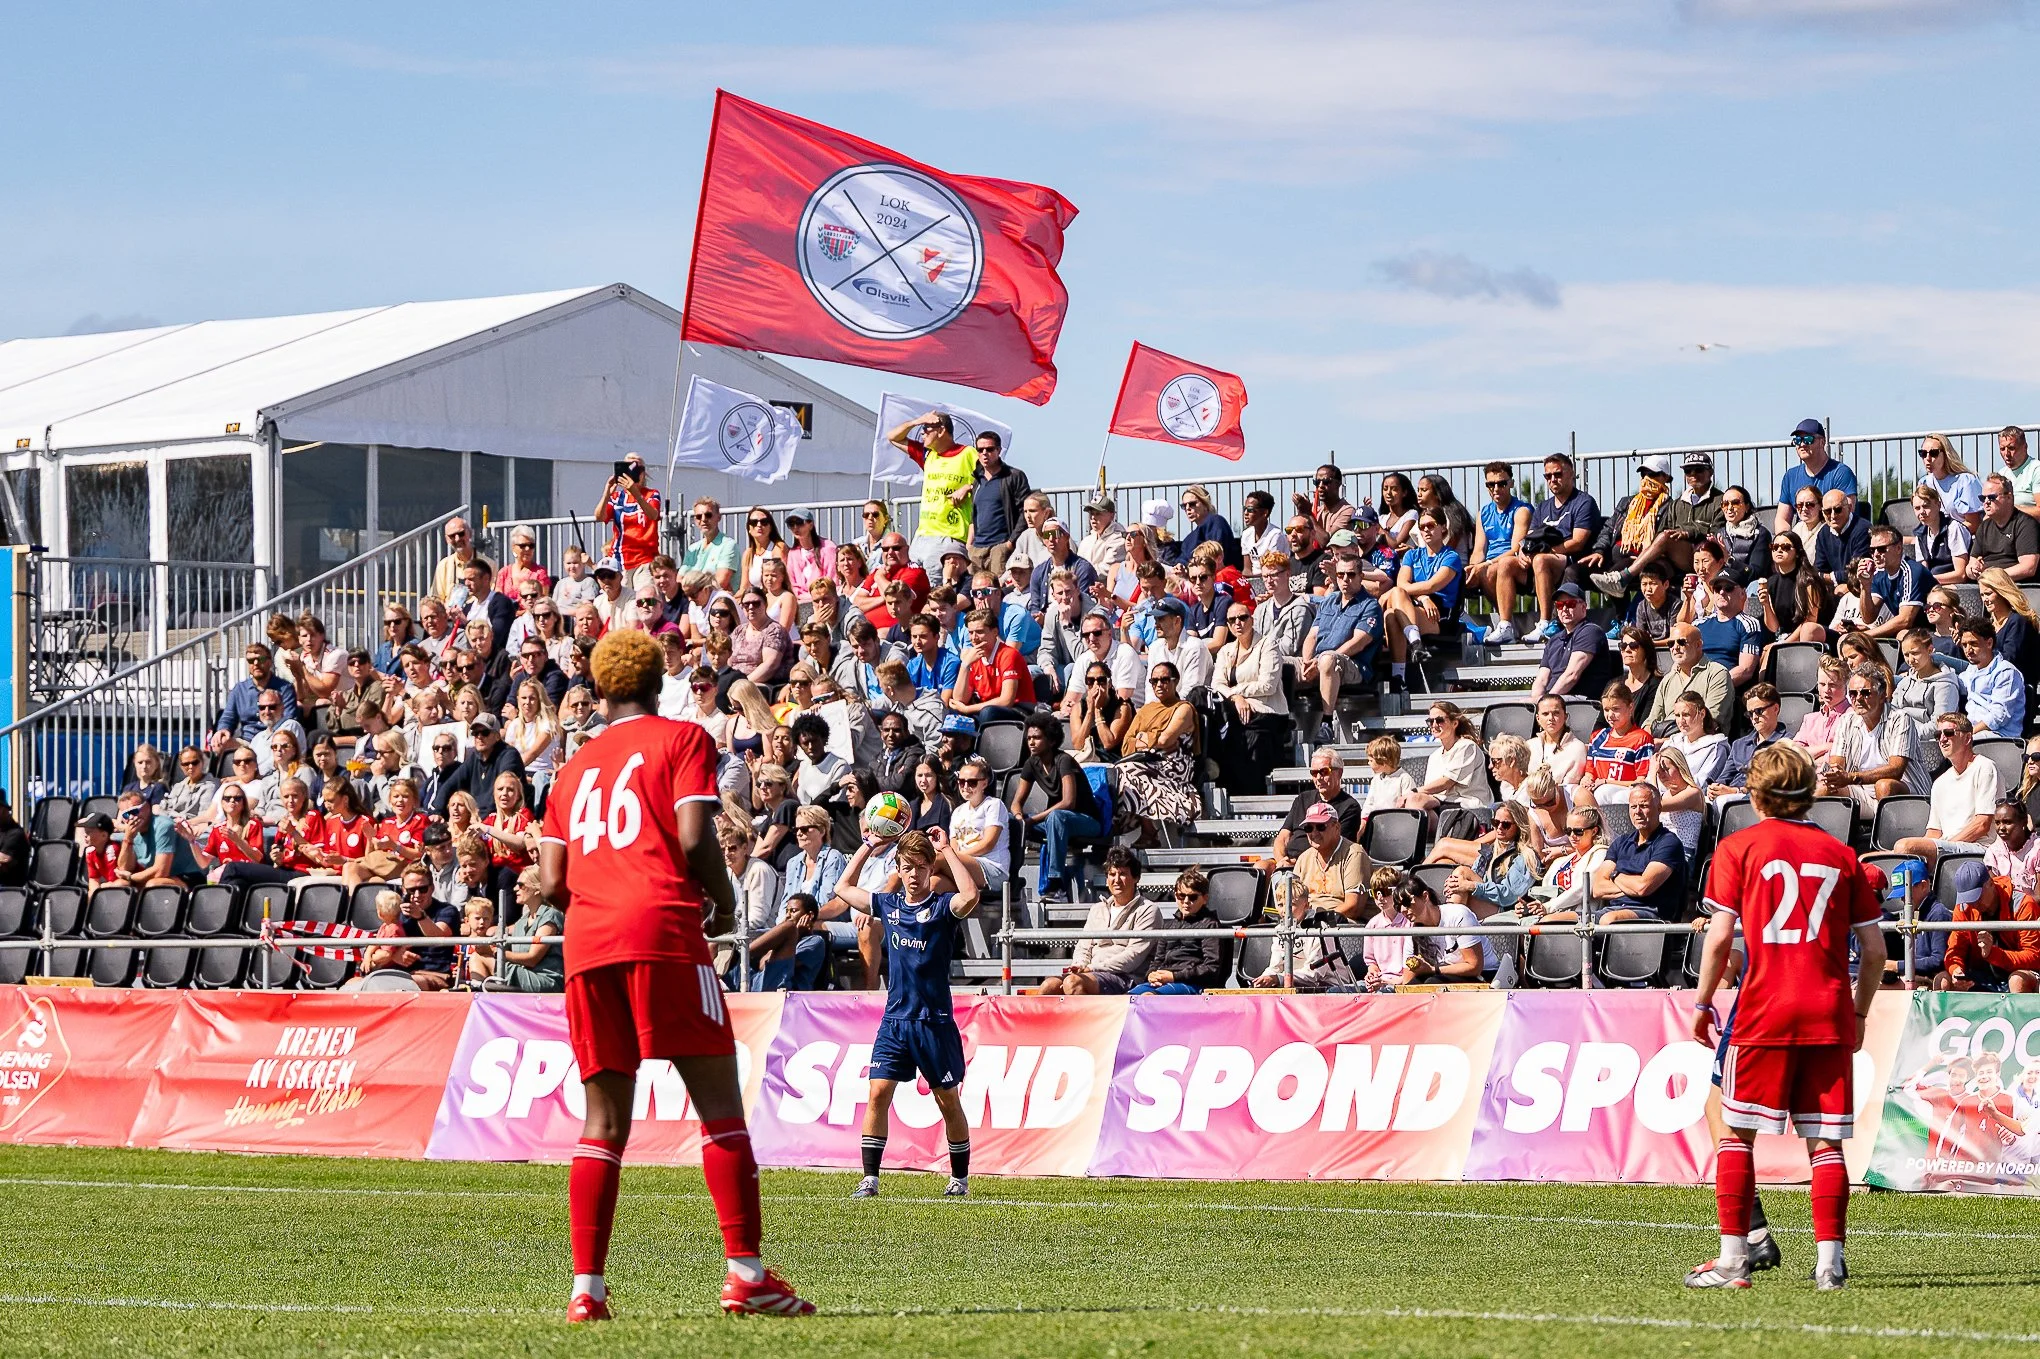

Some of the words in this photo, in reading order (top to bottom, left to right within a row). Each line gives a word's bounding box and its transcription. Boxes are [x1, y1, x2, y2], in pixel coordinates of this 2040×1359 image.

[880, 194, 911, 212] LOK
[876, 213, 908, 230] 2024
[866, 286, 910, 304] Olsvik
[569, 751, 645, 856] 46
[1760, 859, 1841, 944] 27
[900, 937, 927, 951] eviny
[274, 1026, 358, 1056] KREMEN
[246, 1058, 279, 1088] AV
[277, 1059, 358, 1091] ISKREM
[460, 1036, 750, 1121] SPN
[1125, 1041, 1471, 1134] SPOND
[1503, 1041, 1876, 1134] SPO
[1905, 1157, 1974, 1174] POWERED
[1976, 1161, 1997, 1174] BY
